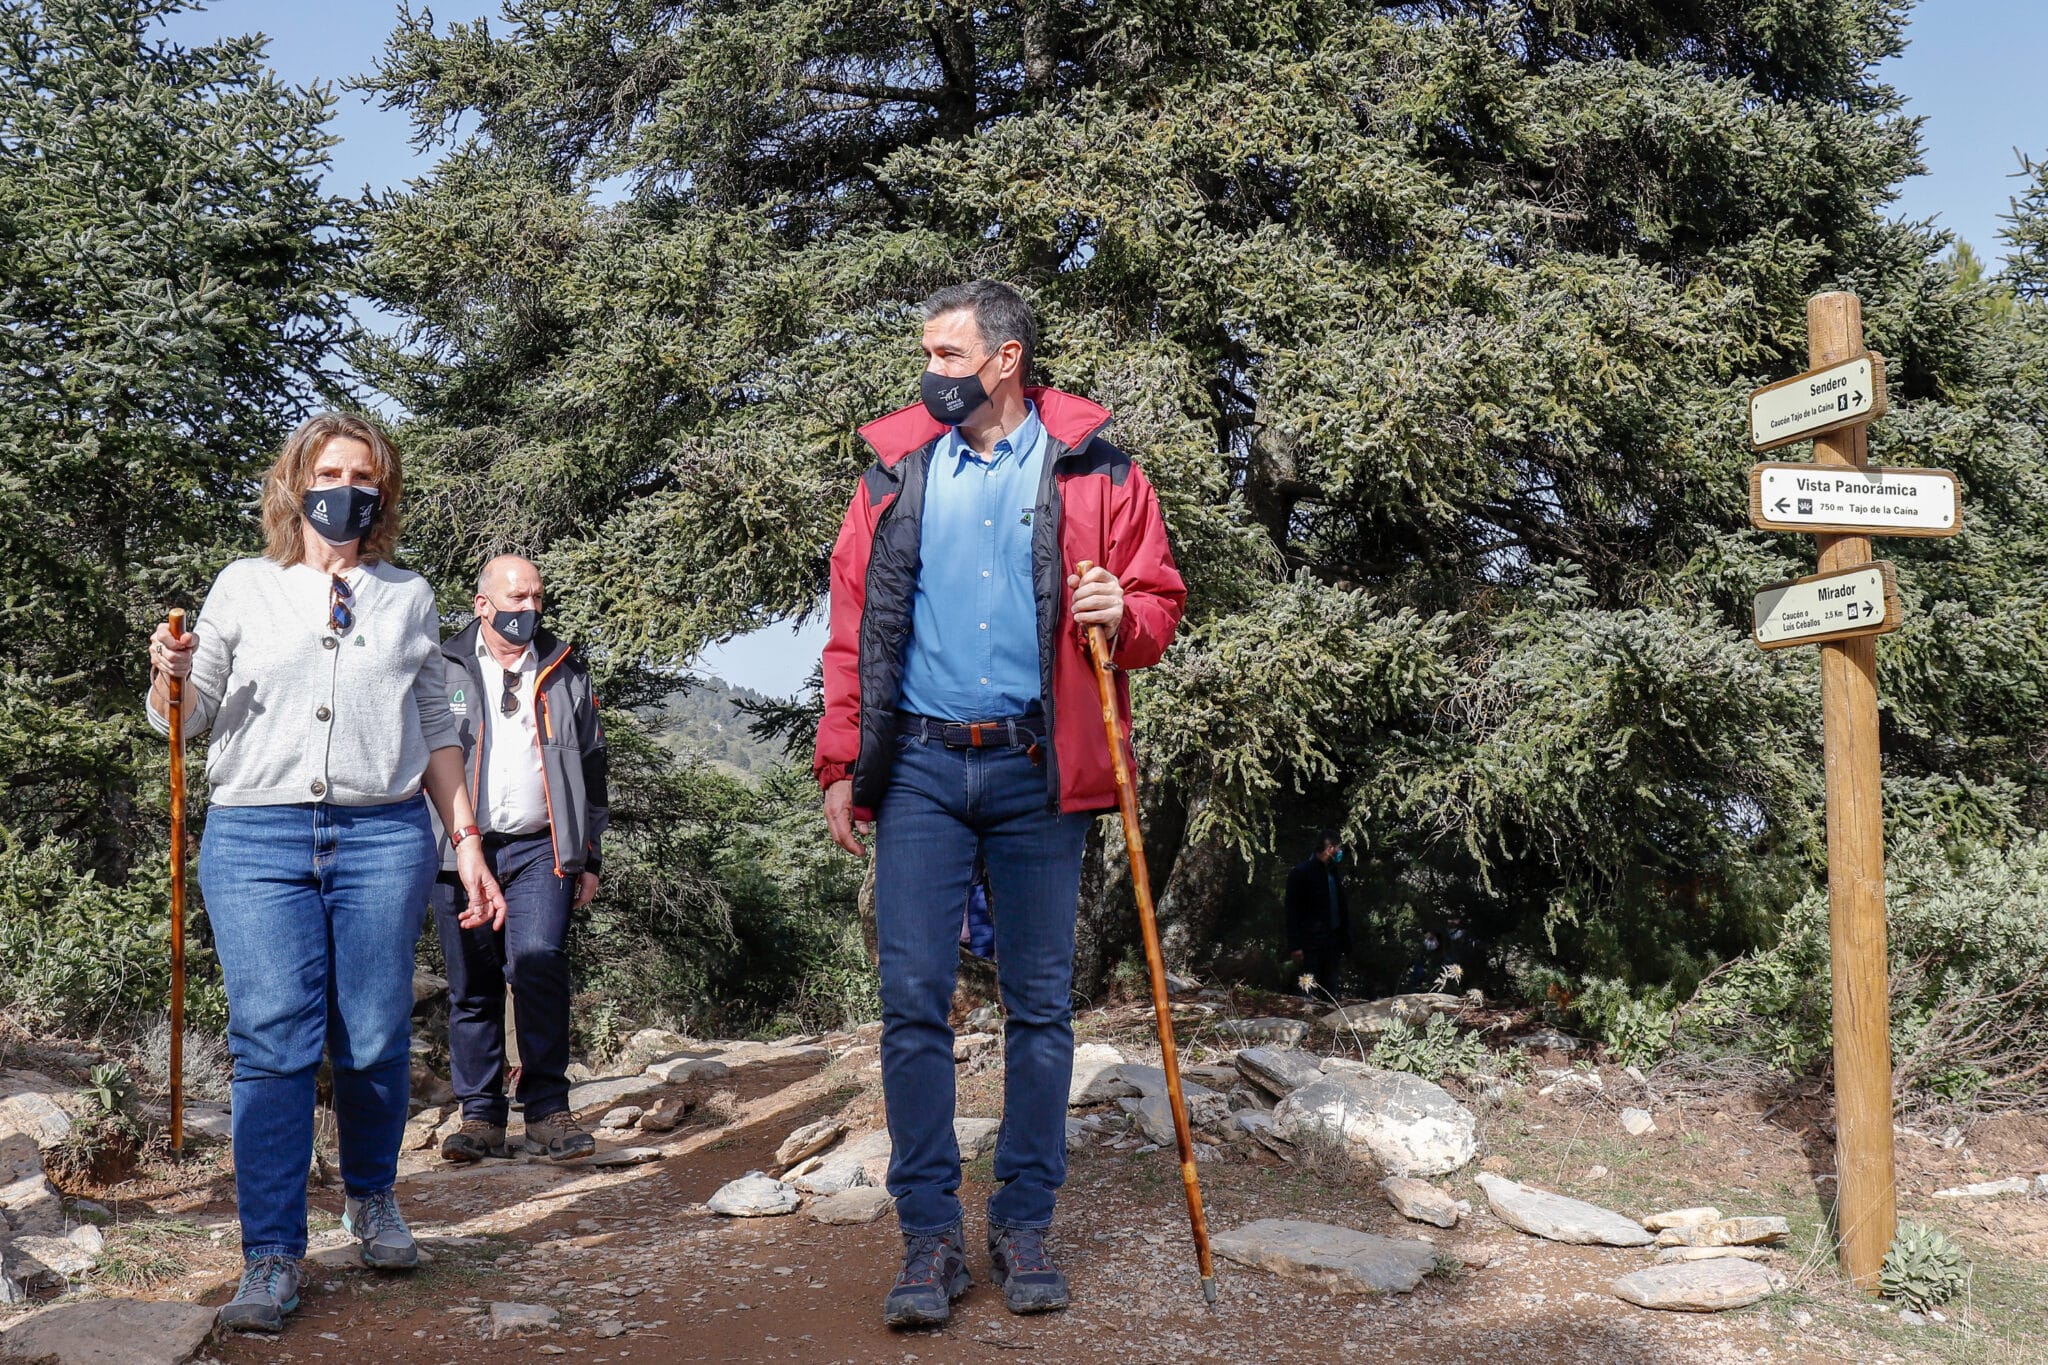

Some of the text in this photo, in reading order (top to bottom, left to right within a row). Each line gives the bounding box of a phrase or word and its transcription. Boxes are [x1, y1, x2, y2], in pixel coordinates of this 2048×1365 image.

[1810, 376, 1847, 397] Sendero
[1791, 412, 1803, 422] Tajo
[1803, 409, 1811, 418] de
[1811, 407, 1817, 416] la
[1796, 478, 1918, 497] Vista Panorámica
[1820, 503, 1835, 511] 750
[1849, 504, 1868, 515] Tajo
[1870, 505, 1881, 514] de
[1883, 505, 1892, 514] la
[1818, 584, 1856, 602] Mirador
[1825, 610, 1844, 620] 2,5 Km
[1783, 619, 1821, 631] Luis Ceballos
